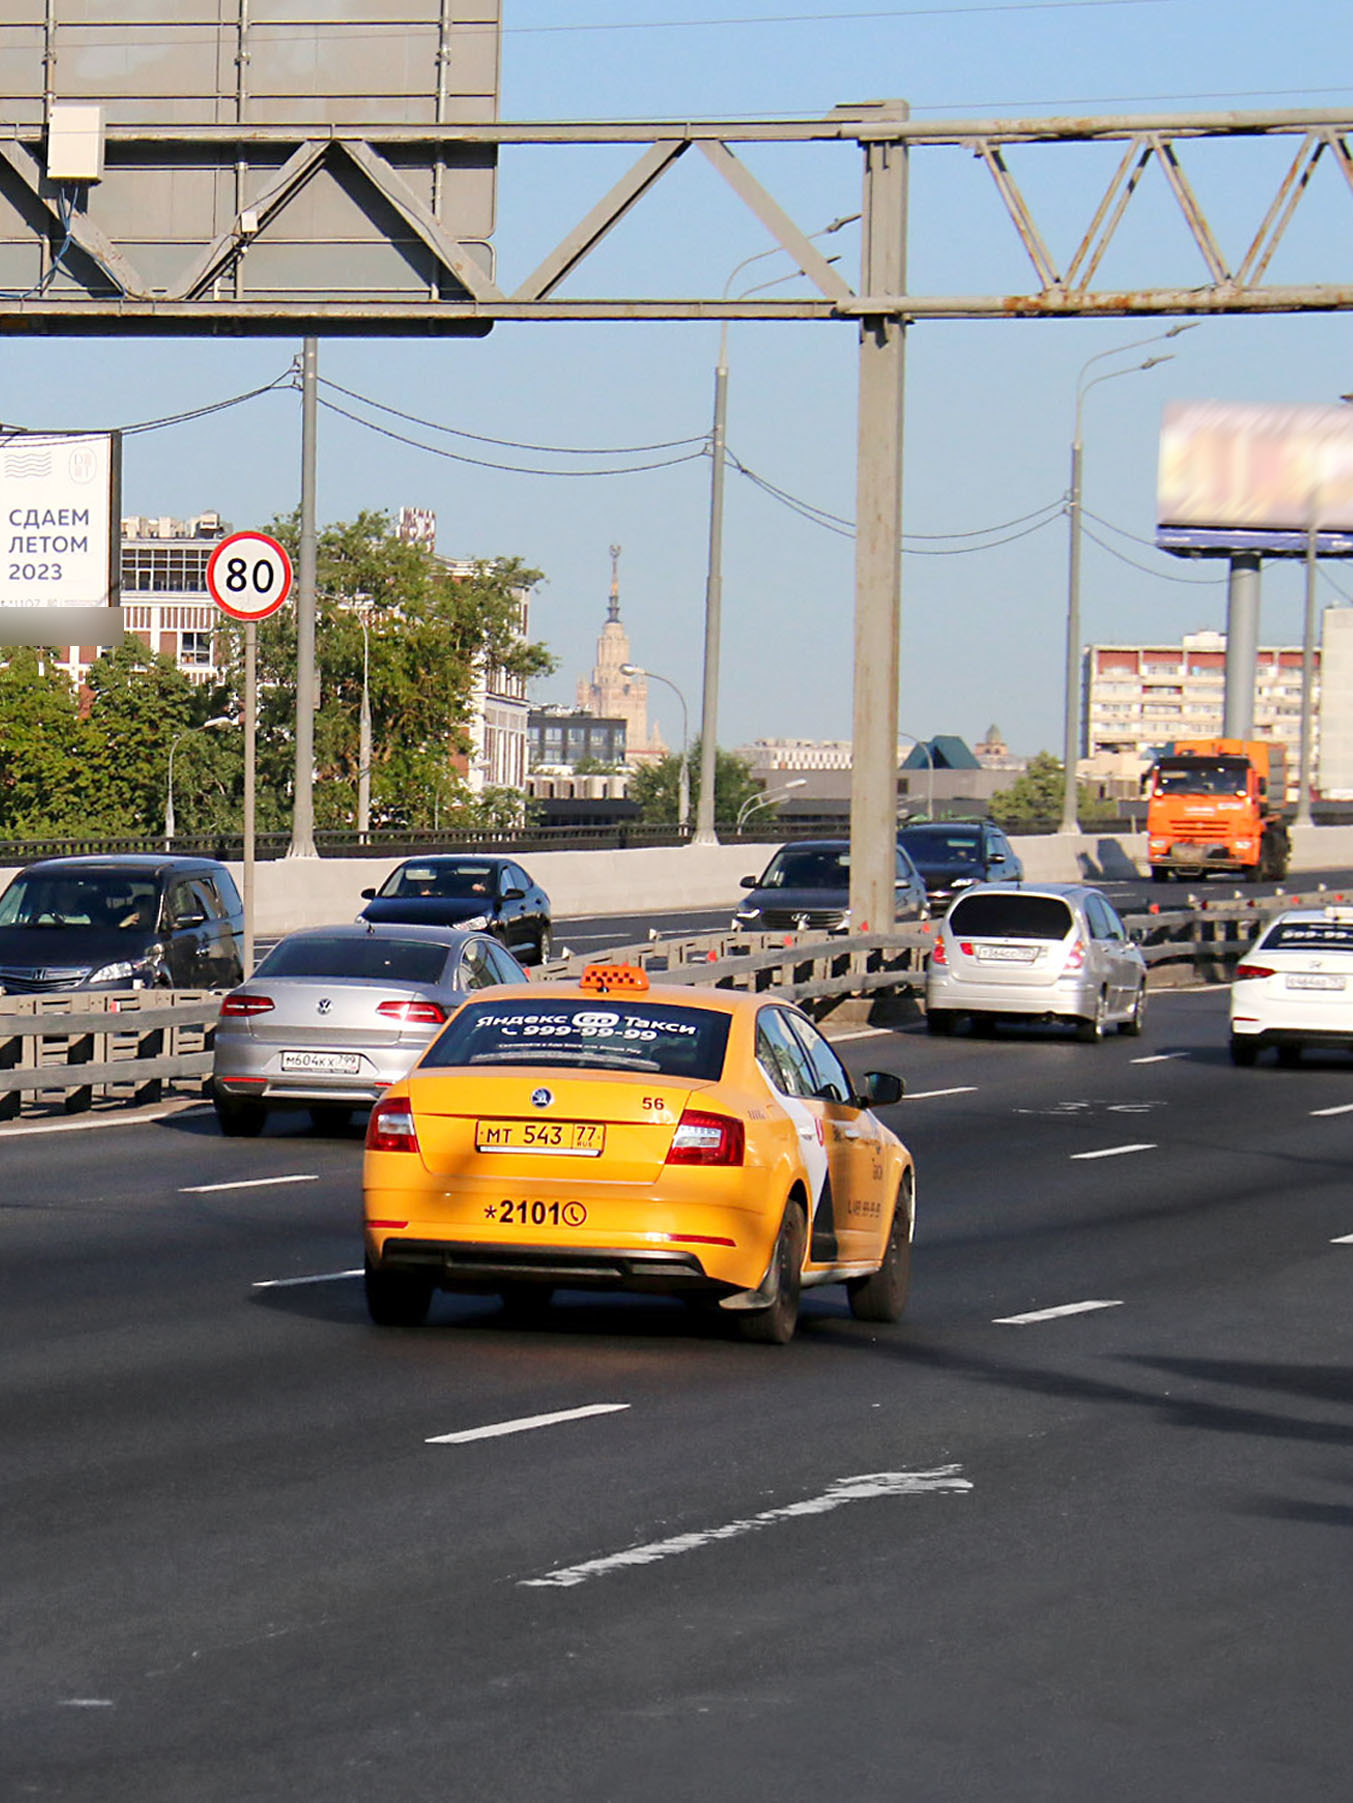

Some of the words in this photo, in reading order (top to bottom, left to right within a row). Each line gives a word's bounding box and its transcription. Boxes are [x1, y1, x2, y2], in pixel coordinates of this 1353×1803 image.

[9, 508, 89, 529] СДАЕМ
[8, 536, 88, 553] ЛЕТОМ
[8, 563, 63, 580] 2023
[226, 557, 274, 594] 80
[475, 1015, 568, 1028] Яндекс
[624, 1015, 696, 1035] Такси
[522, 1025, 658, 1041] 999-99-99
[642, 1097, 664, 1110] 56
[486, 1128, 512, 1143] МТ
[523, 1126, 563, 1145] 543
[576, 1126, 597, 1141] 77
